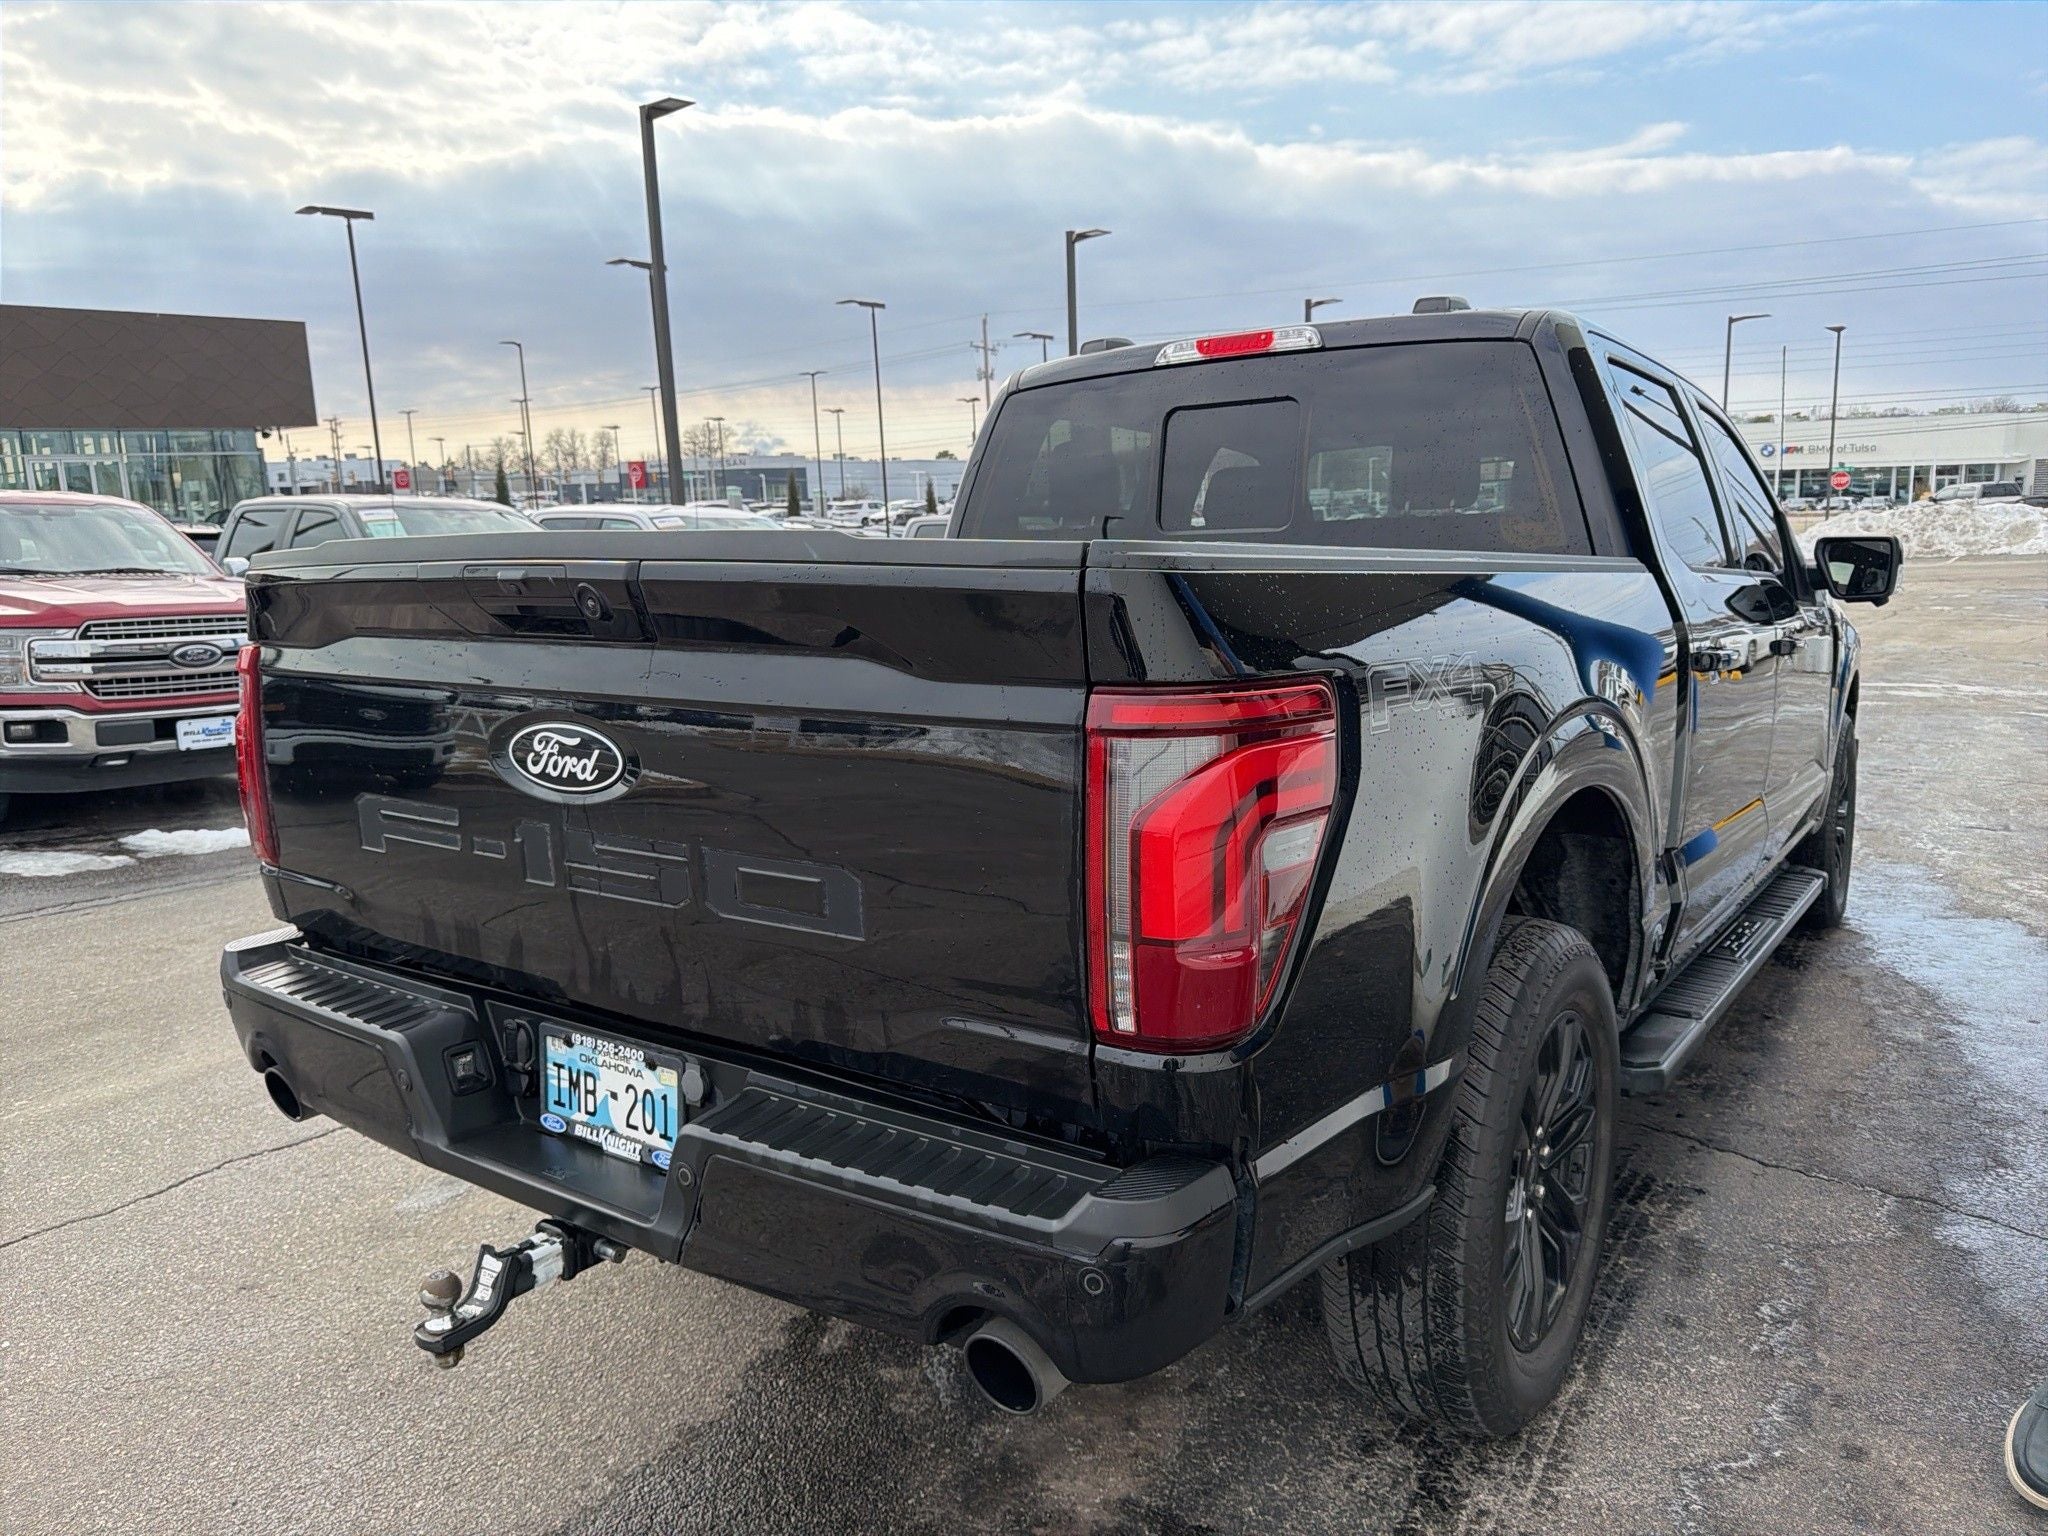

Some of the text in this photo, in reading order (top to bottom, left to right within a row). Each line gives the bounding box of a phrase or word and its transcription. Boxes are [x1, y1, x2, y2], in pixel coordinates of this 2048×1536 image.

[1837, 444, 1847, 453] of
[1850, 443, 1877, 452] Tulsa
[1833, 476, 1850, 485] STOP
[186, 649, 212, 660] Ford
[1365, 650, 1484, 735] FX4
[527, 731, 600, 782] Ford
[356, 791, 865, 941] F-150
[571, 1032, 596, 1050] (918)
[596, 1038, 645, 1062] 526-2400
[579, 1053, 645, 1080] OKLAHOMA
[546, 1117, 561, 1130] Ford
[625, 1083, 674, 1143] 201
[574, 1123, 600, 1143] BILL
[598, 1127, 643, 1154] KNIGHT
